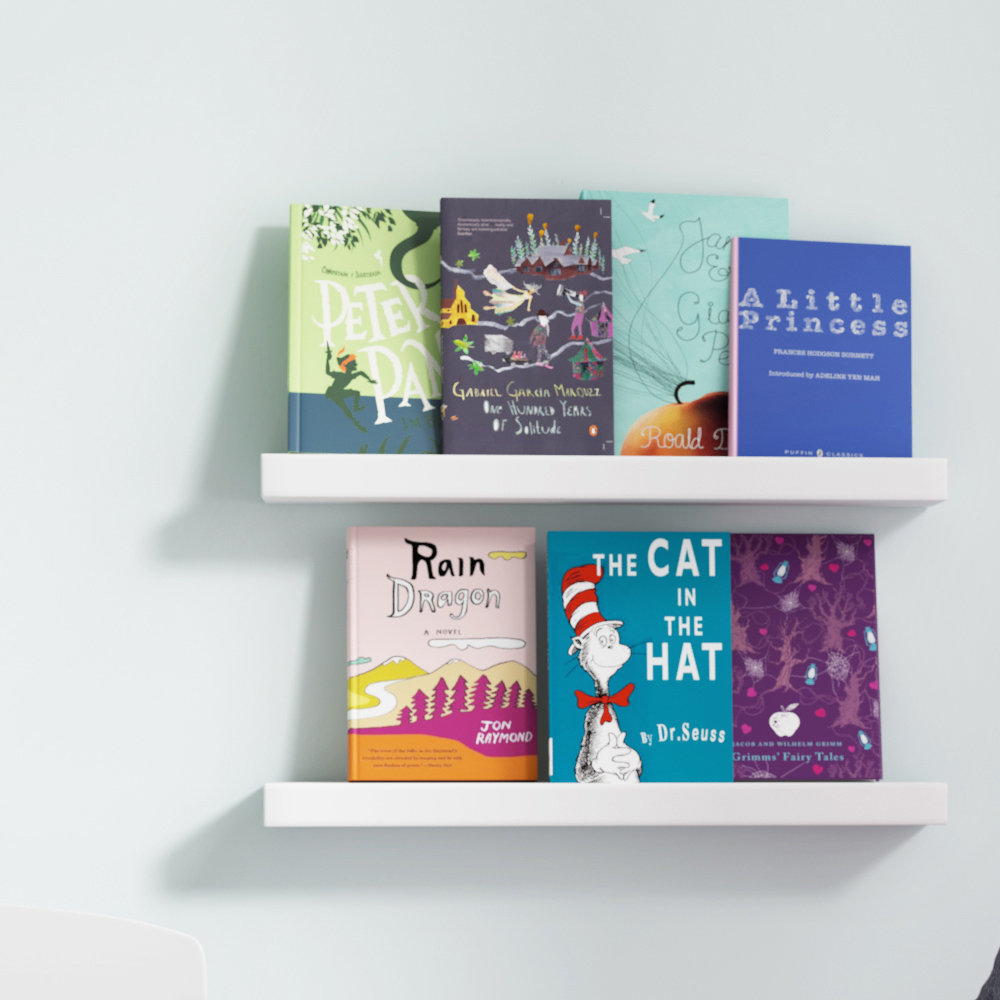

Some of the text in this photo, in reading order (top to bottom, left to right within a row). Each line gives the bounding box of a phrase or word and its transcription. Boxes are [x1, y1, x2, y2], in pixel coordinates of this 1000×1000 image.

[312, 274, 441, 347] PETER
[738, 287, 909, 316] A Little
[738, 310, 909, 338] Princess
[773, 348, 806, 356] FRANCES
[807, 349, 841, 358] HODGSON
[768, 370, 805, 378] Introduced
[806, 371, 814, 380] by
[815, 372, 847, 380] ADELINE
[640, 425, 705, 450] Roald
[404, 537, 485, 580] Rain
[592, 537, 723, 578] THE CAT
[677, 588, 697, 607] IN
[664, 616, 704, 636] THE
[646, 642, 724, 681] HAT
[480, 720, 512, 733] JON
[475, 732, 533, 745] RAYMOND
[640, 731, 653, 746] By
[783, 751, 813, 763] Fairy
[815, 751, 845, 761] Tales
